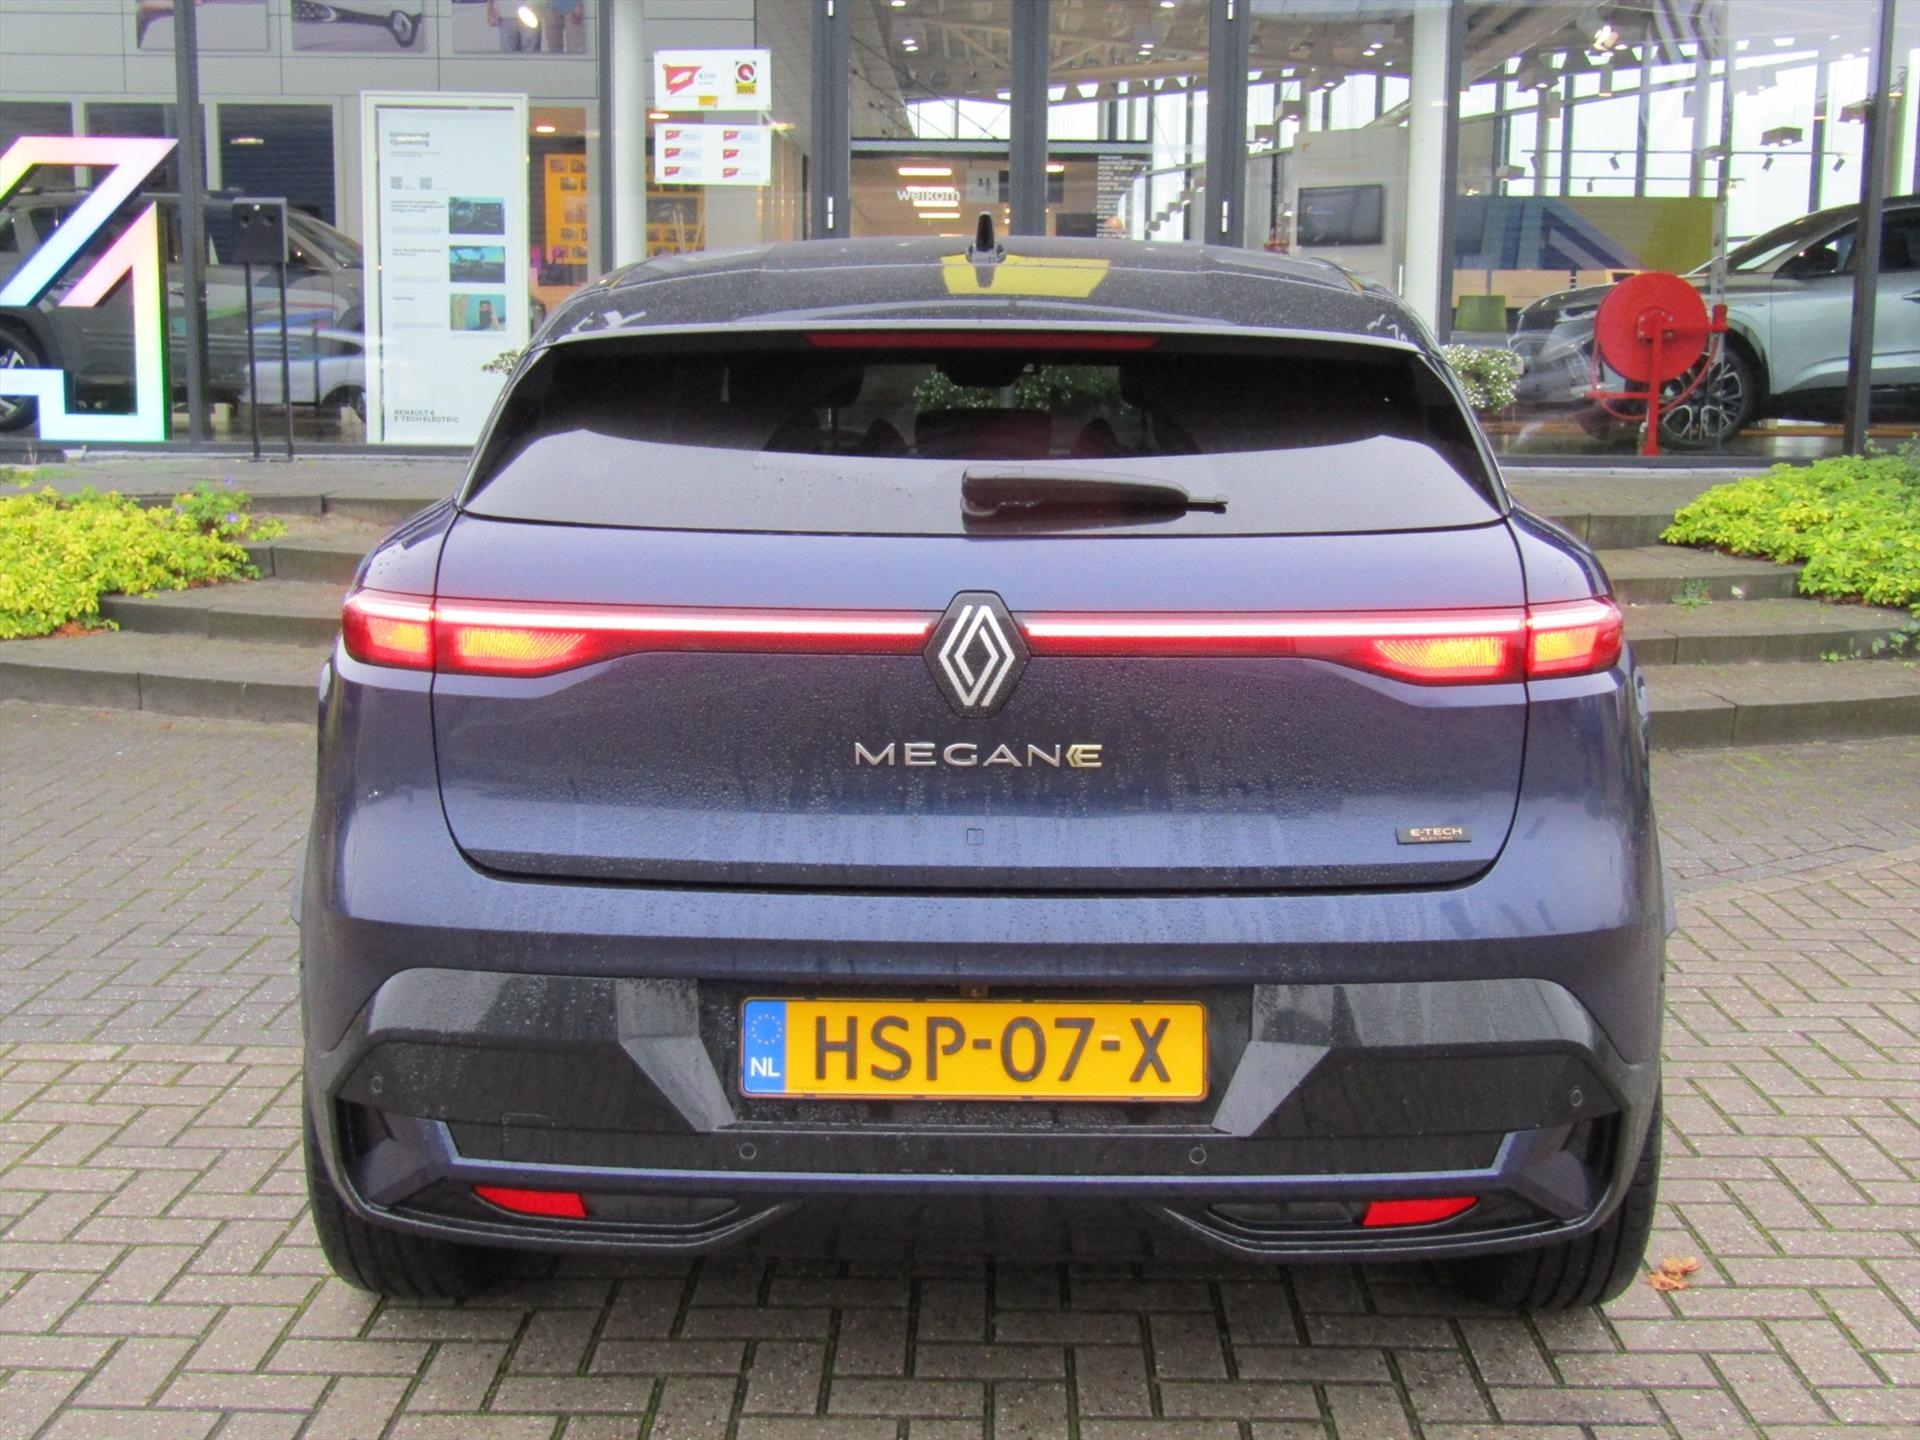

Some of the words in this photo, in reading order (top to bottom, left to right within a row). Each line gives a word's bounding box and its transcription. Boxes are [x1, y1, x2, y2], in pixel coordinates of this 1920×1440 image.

[896, 188, 960, 202] welkom
[854, 742, 1103, 768] MEGANE
[1410, 827, 1463, 837] E-TECH
[814, 1015, 1172, 1083] HSP-07-X
[750, 1056, 781, 1078] NL
